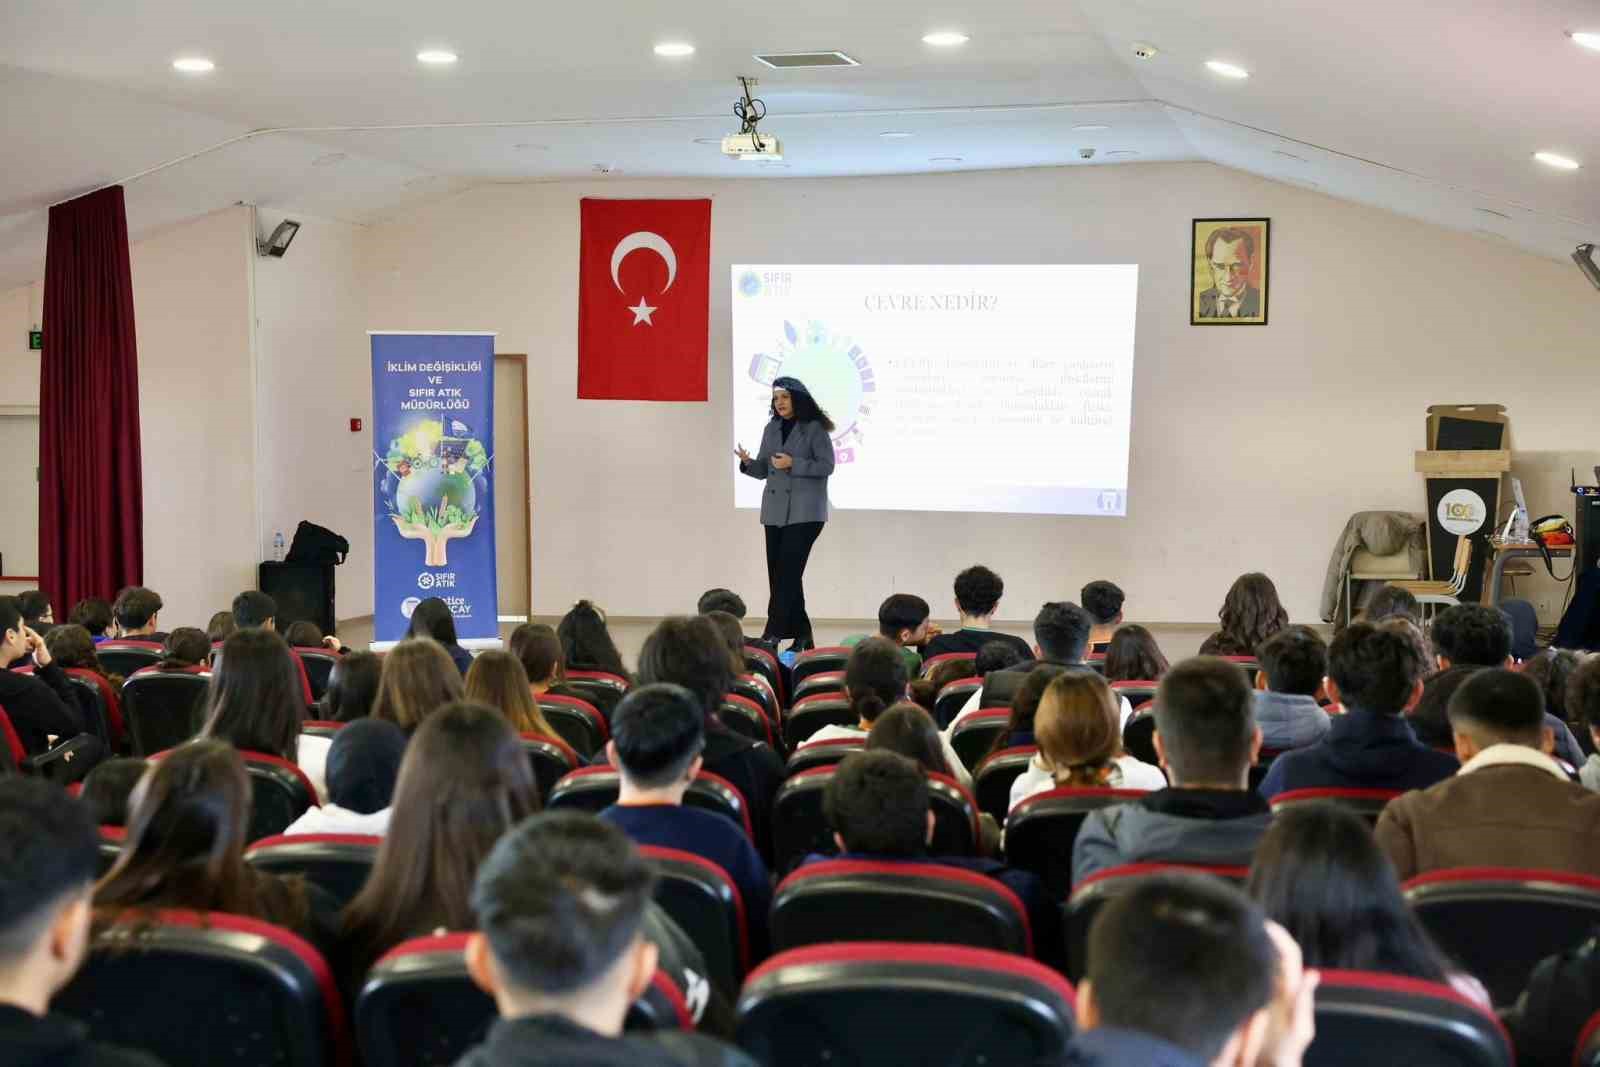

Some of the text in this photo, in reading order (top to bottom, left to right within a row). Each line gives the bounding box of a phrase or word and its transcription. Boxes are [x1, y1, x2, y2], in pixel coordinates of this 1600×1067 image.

[387, 360, 482, 373] İKLİM DEĞİŞİKLİĞİ
[428, 376, 443, 385] VE
[408, 388, 462, 397] SIFIR ATIK
[400, 399, 470, 410] MÜDÜRLÜĞÜ
[435, 572, 456, 580] SIFIR
